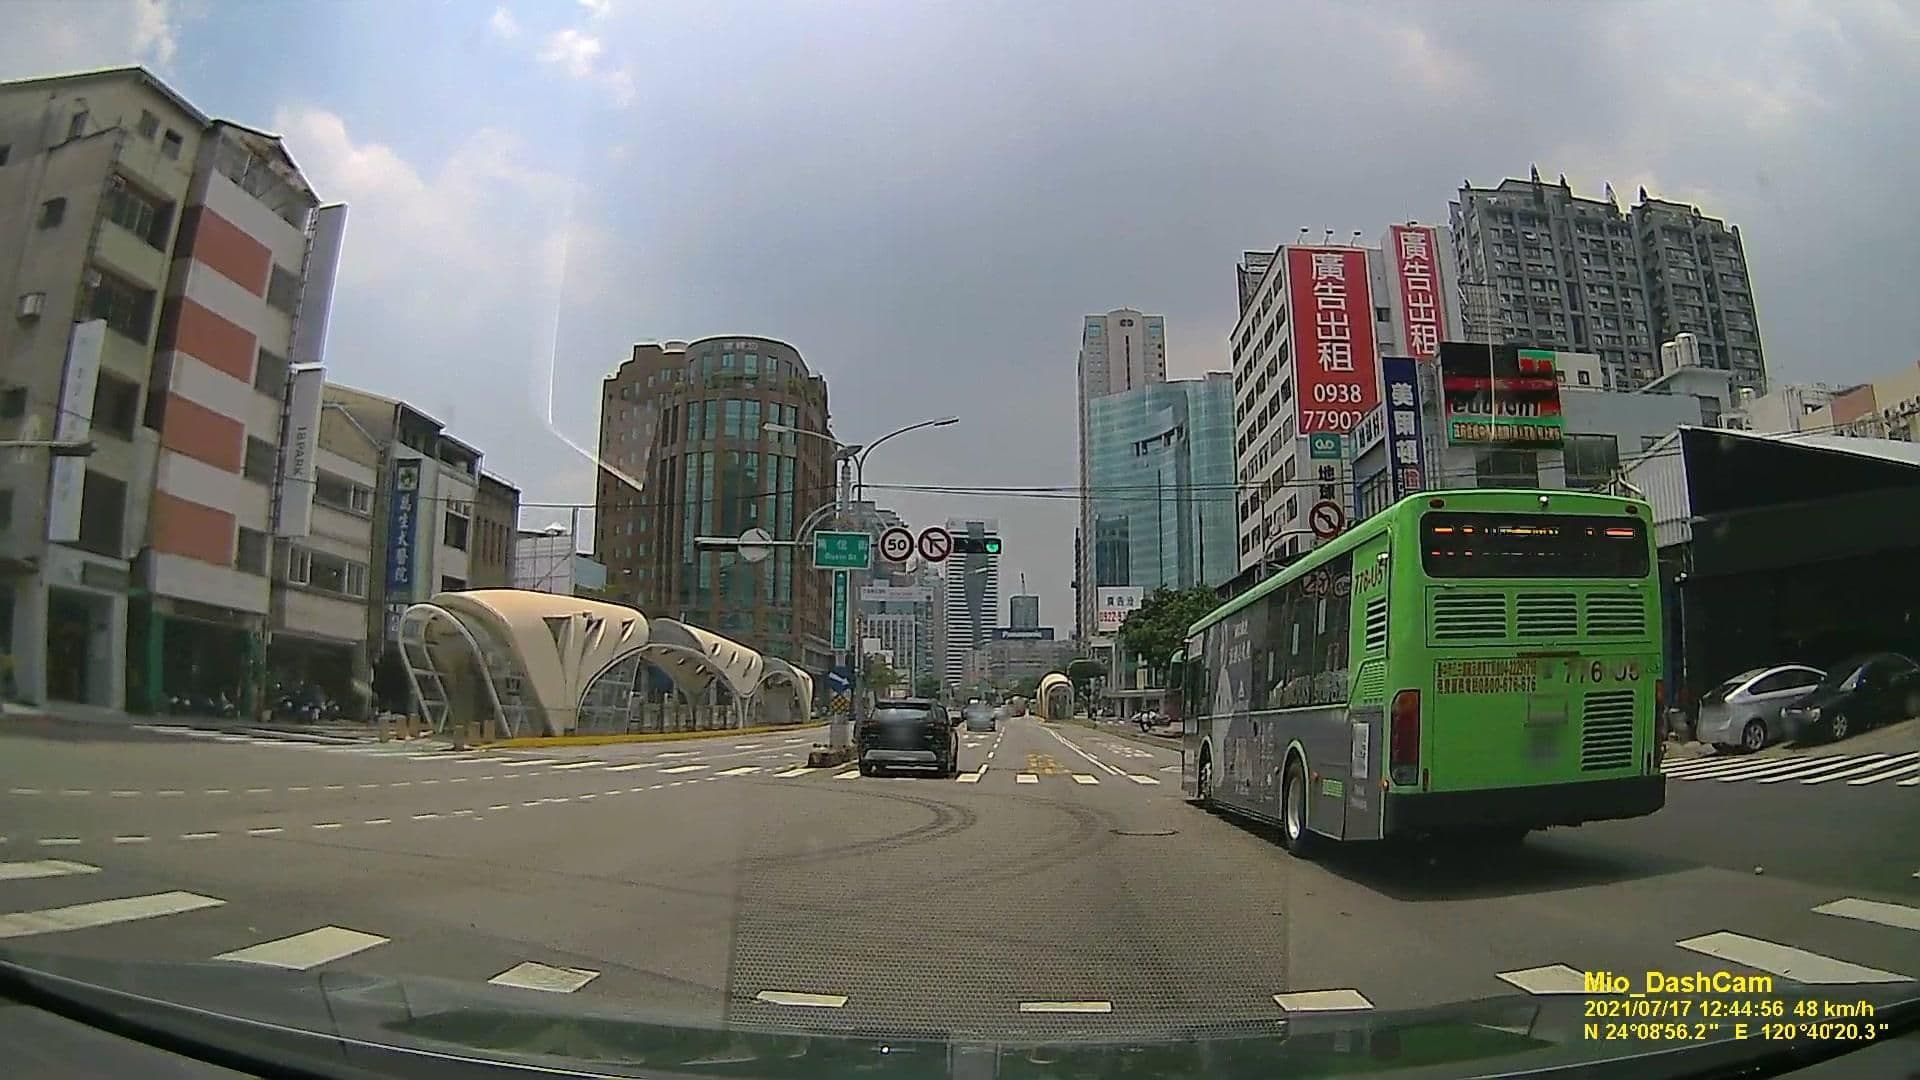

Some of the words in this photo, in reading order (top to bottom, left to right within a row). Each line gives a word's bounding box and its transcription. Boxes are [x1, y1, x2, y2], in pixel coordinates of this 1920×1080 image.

[1401, 231, 1438, 355] 廣告出租
[1311, 252, 1354, 372] 廣告出租
[1314, 383, 1362, 402] 0938
[1303, 410, 1367, 430] 77902
[887, 539, 907, 551] 50
